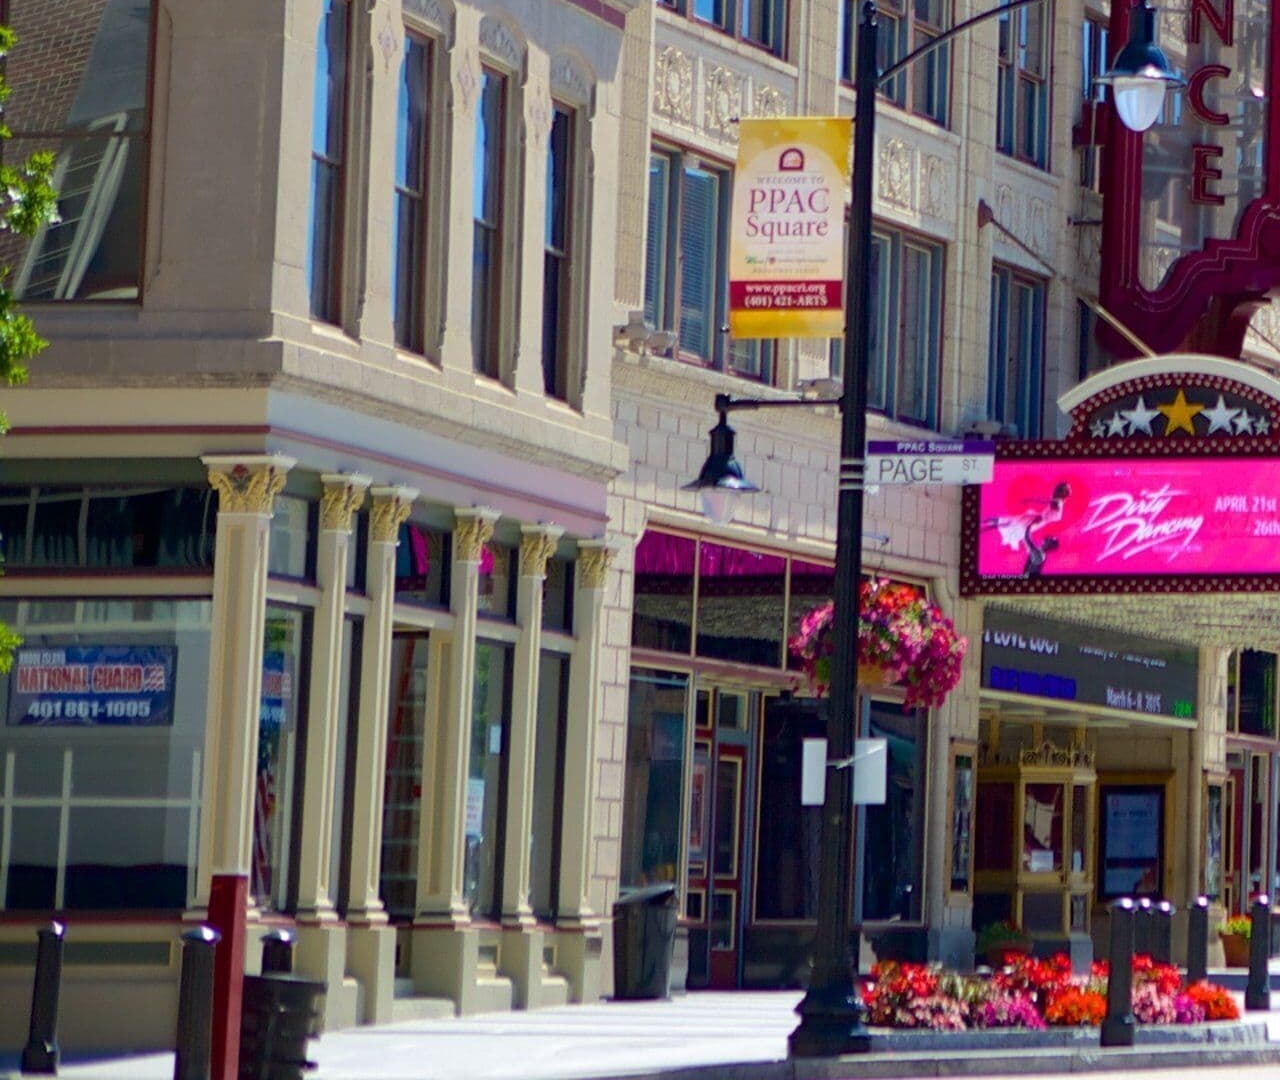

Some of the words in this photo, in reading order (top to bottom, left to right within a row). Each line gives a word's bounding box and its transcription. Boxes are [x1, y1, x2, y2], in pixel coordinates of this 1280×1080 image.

[756, 176, 806, 185] WELCOME
[811, 176, 825, 185] TO
[748, 187, 831, 215] PPAC
[746, 215, 829, 245] Square
[744, 282, 827, 297] www.ppacri.org
[744, 295, 772, 310] (401)
[774, 295, 829, 308] 421-ARTS
[896, 443, 926, 453] PPAC
[879, 458, 944, 482] PAGE
[1081, 483, 1189, 534] Dirty
[1214, 495, 1248, 514] APRIL
[1250, 495, 1277, 514] 21st
[1096, 514, 1204, 562] Dancing
[16, 664, 91, 694] NATIONAL
[91, 664, 145, 694] GUARD
[1106, 685, 1127, 708] March
[27, 700, 62, 718] 401
